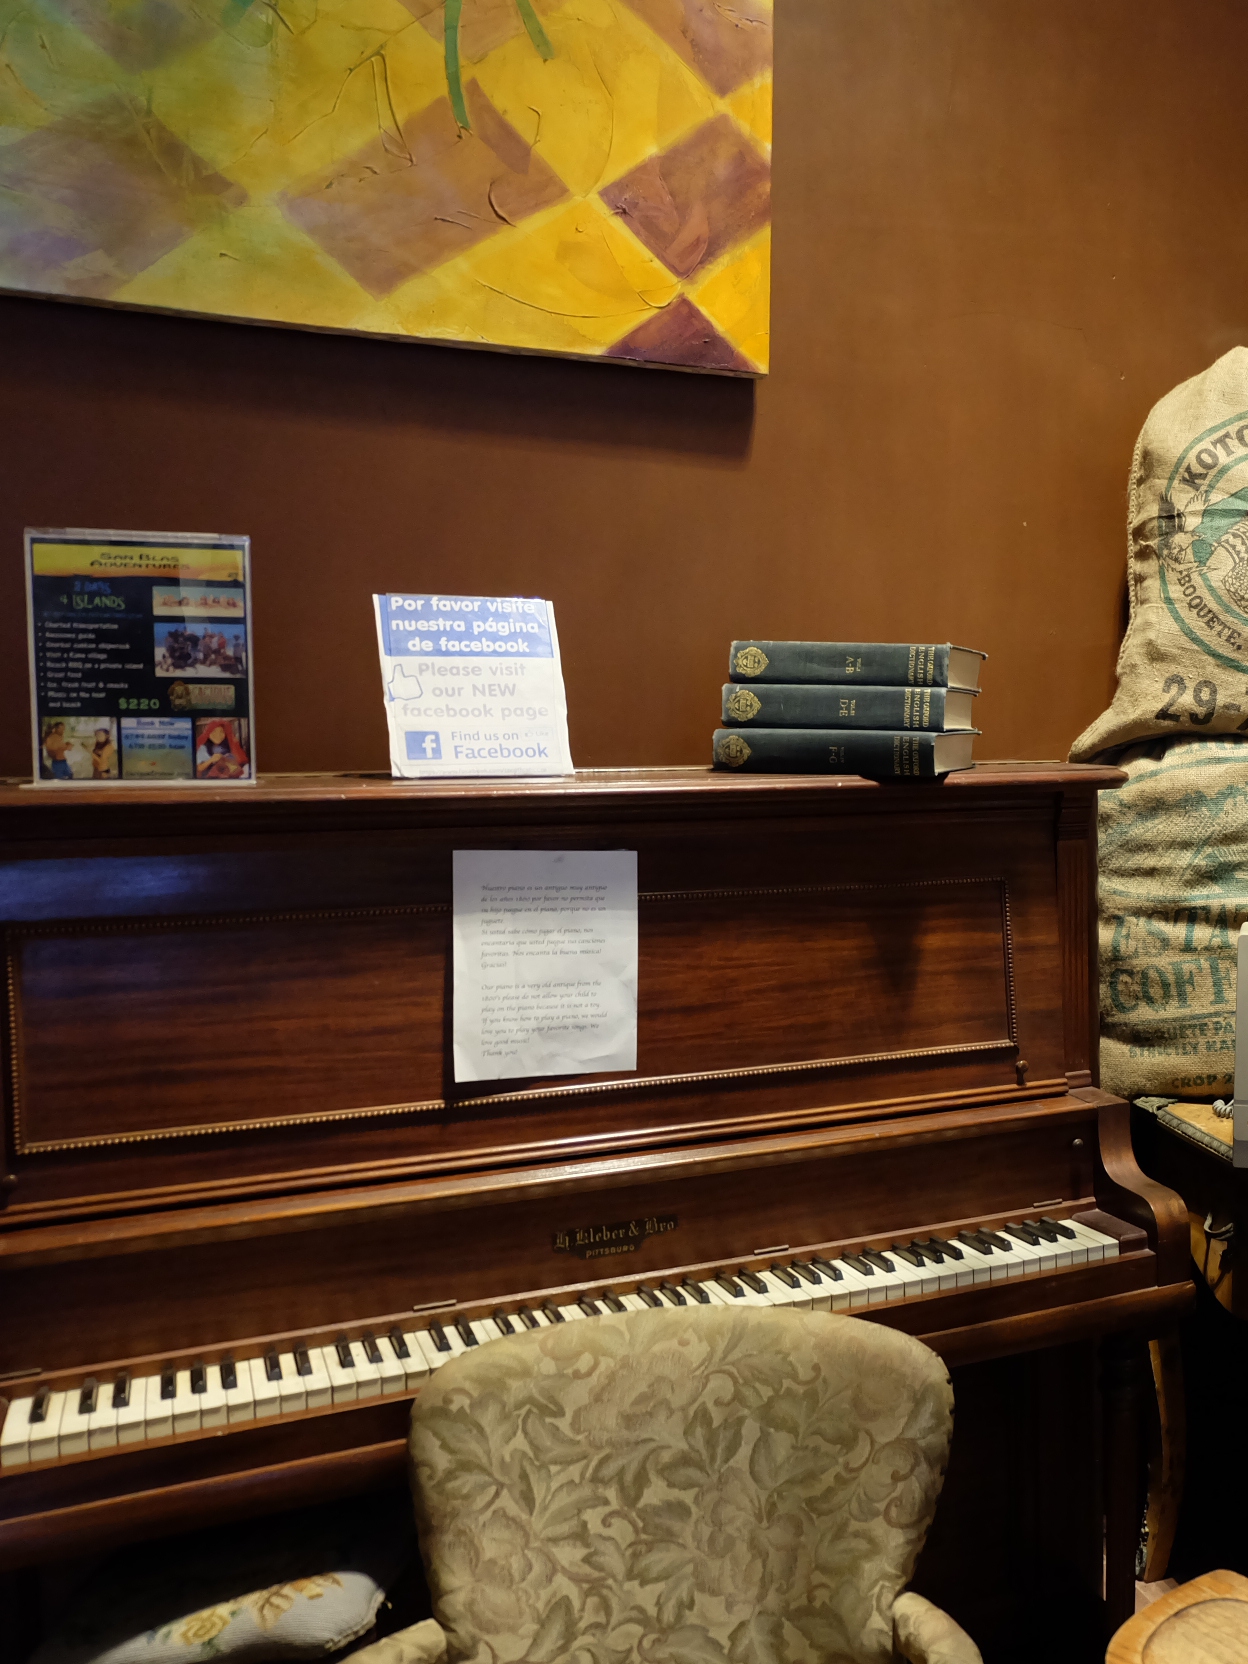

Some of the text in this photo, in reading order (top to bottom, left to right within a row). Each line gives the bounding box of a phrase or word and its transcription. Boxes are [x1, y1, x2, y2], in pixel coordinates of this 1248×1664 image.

[72, 595, 126, 610] ISLANDS
[391, 597, 535, 614] Por favor visite
[391, 617, 539, 636] nuestra página
[408, 637, 530, 653] de facebook
[418, 662, 526, 677] Please visit
[845, 656, 855, 674] A-B
[908, 646, 917, 685] DICTIONARY
[918, 646, 926, 685] ENGLISH
[432, 683, 516, 698] our NEW
[118, 697, 160, 710] $220
[839, 699, 849, 717] D-E
[904, 688, 912, 729] DICTIONARY
[913, 688, 921, 728] ENGLISH
[401, 704, 549, 721] facebook page
[451, 731, 519, 742] Find us on
[454, 743, 549, 760] Facebook
[903, 736, 911, 776] ENGLISH
[1171, 1073, 1219, 1090] CROP
[628, 1220, 640, 1238] &
